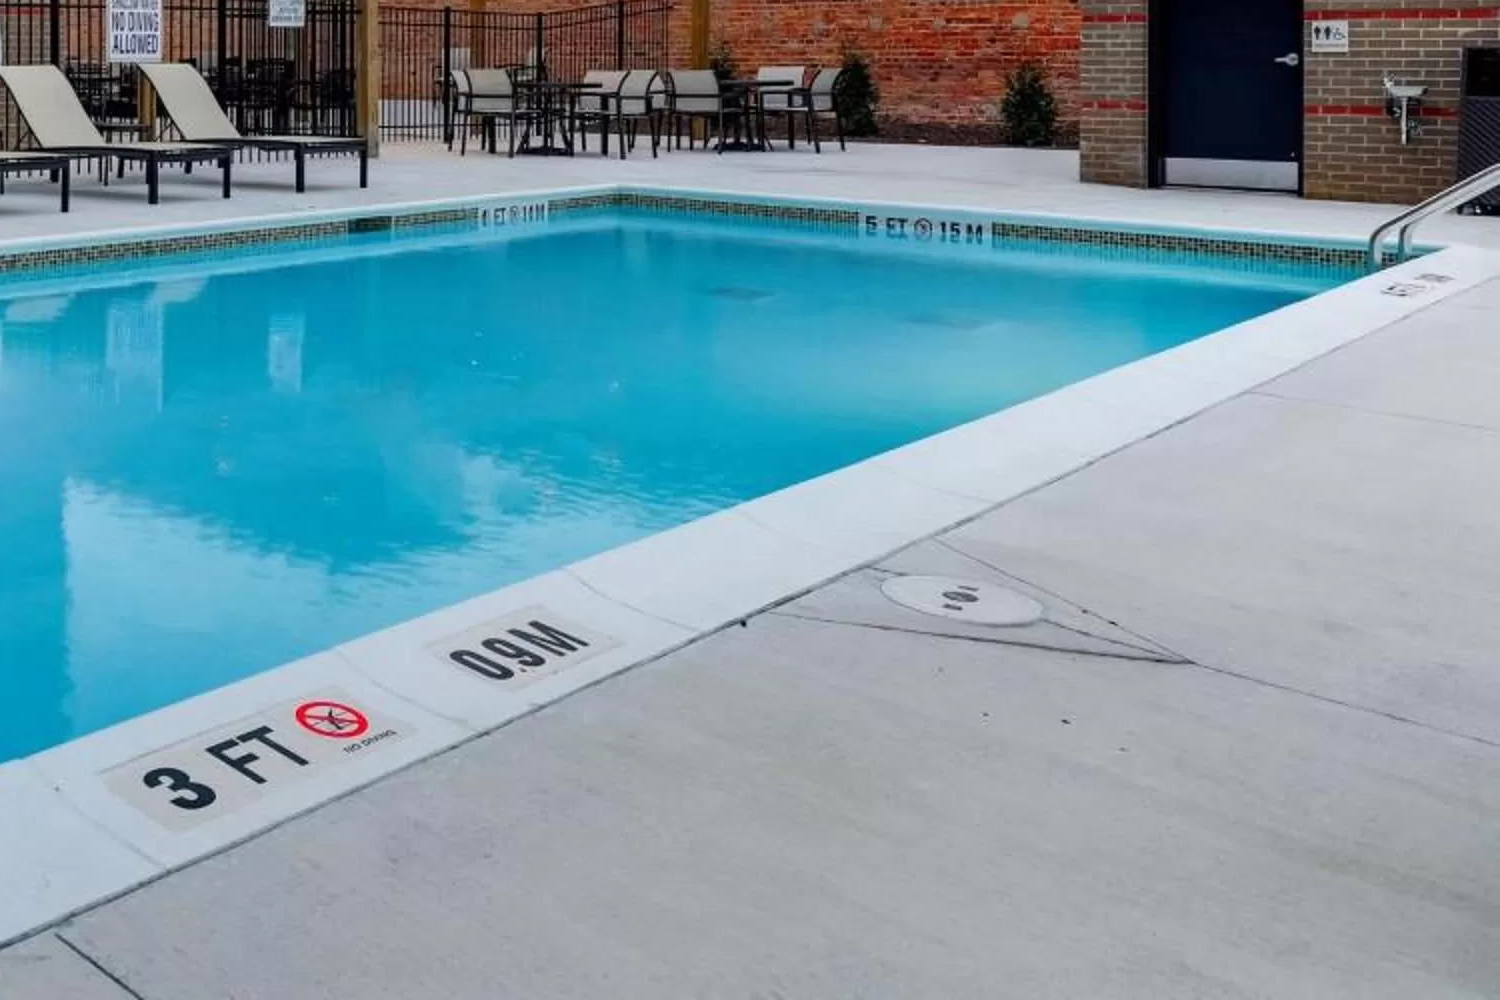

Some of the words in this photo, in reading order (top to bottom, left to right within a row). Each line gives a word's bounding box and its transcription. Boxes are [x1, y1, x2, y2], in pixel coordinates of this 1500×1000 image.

[111, 11, 125, 33] NO
[111, 33, 159, 55] ALLOWED
[343, 742, 363, 754] NO
[143, 767, 216, 810] 3
[204, 725, 309, 784] FT
